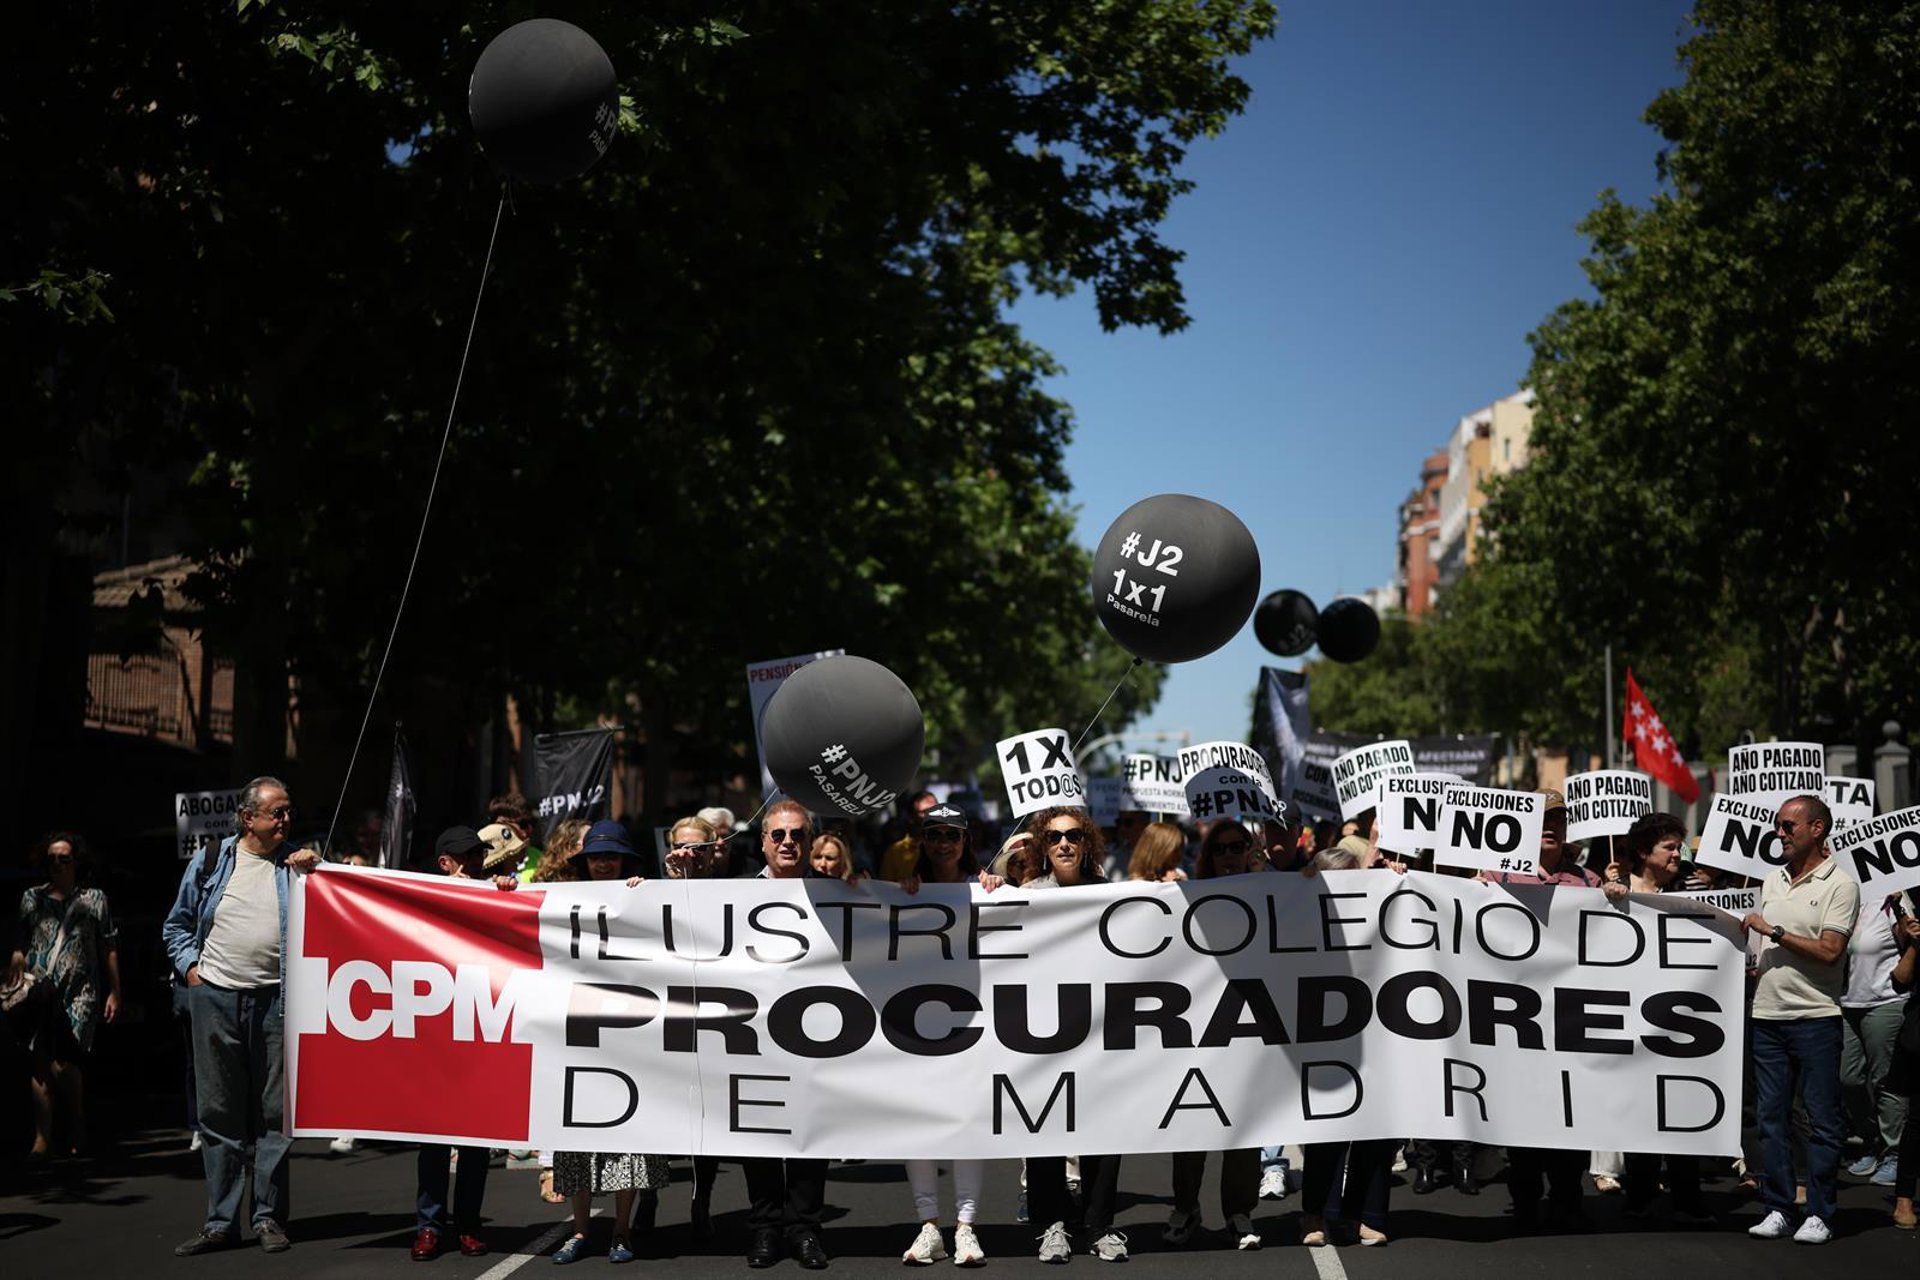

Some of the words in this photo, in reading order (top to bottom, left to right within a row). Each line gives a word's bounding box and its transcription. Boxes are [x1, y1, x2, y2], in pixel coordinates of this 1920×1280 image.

[1120, 531, 1183, 577] #J2
[1113, 568, 1167, 613] 1x1
[1107, 593, 1160, 627] Pasarela
[750, 661, 802, 682] PENSIÓ
[1124, 759, 1182, 783] #PNJ
[1334, 758, 1355, 784] AÑO
[1356, 746, 1409, 772] PAGADO
[1732, 748, 1758, 772] AÑO
[1763, 748, 1821, 769] PAGADO
[821, 744, 897, 808] #PNJ2
[1011, 773, 1082, 804] TOD@S
[1219, 775, 1248, 784] con
[1251, 775, 1263, 787] la
[1389, 779, 1466, 794] EXCLUSI
[1567, 777, 1591, 802] AÑO
[1595, 776, 1649, 799] PAGADO
[1732, 771, 1756, 795] AÑO
[1760, 770, 1822, 792] COTIZADO
[180, 794, 240, 816] ABOGA
[1163, 789, 1185, 798] NORMA
[1338, 779, 1358, 805] AÑO
[1446, 790, 1534, 813] EXCLUSIONES
[1824, 781, 1872, 807] TA
[205, 820, 228, 829] con
[1403, 797, 1442, 831] N
[1567, 800, 1589, 825] AÑO
[1592, 799, 1650, 819] COTIZADO
[1716, 798, 1778, 825] EXCLUSI
[1451, 810, 1522, 853] NO
[1720, 818, 1785, 866] NO
[1500, 858, 1532, 872] #J2
[1850, 831, 1920, 883] NO
[570, 899, 1030, 963] ILUSTRE
[1099, 889, 1541, 962] COLEGIO
[1578, 909, 1719, 970] DE
[1746, 954, 1758, 967] J2
[299, 957, 538, 1044] ICPM
[565, 970, 1725, 1059] PROCURADORES
[562, 1066, 792, 1135] DE
[992, 1057, 1726, 1136] MADRID
